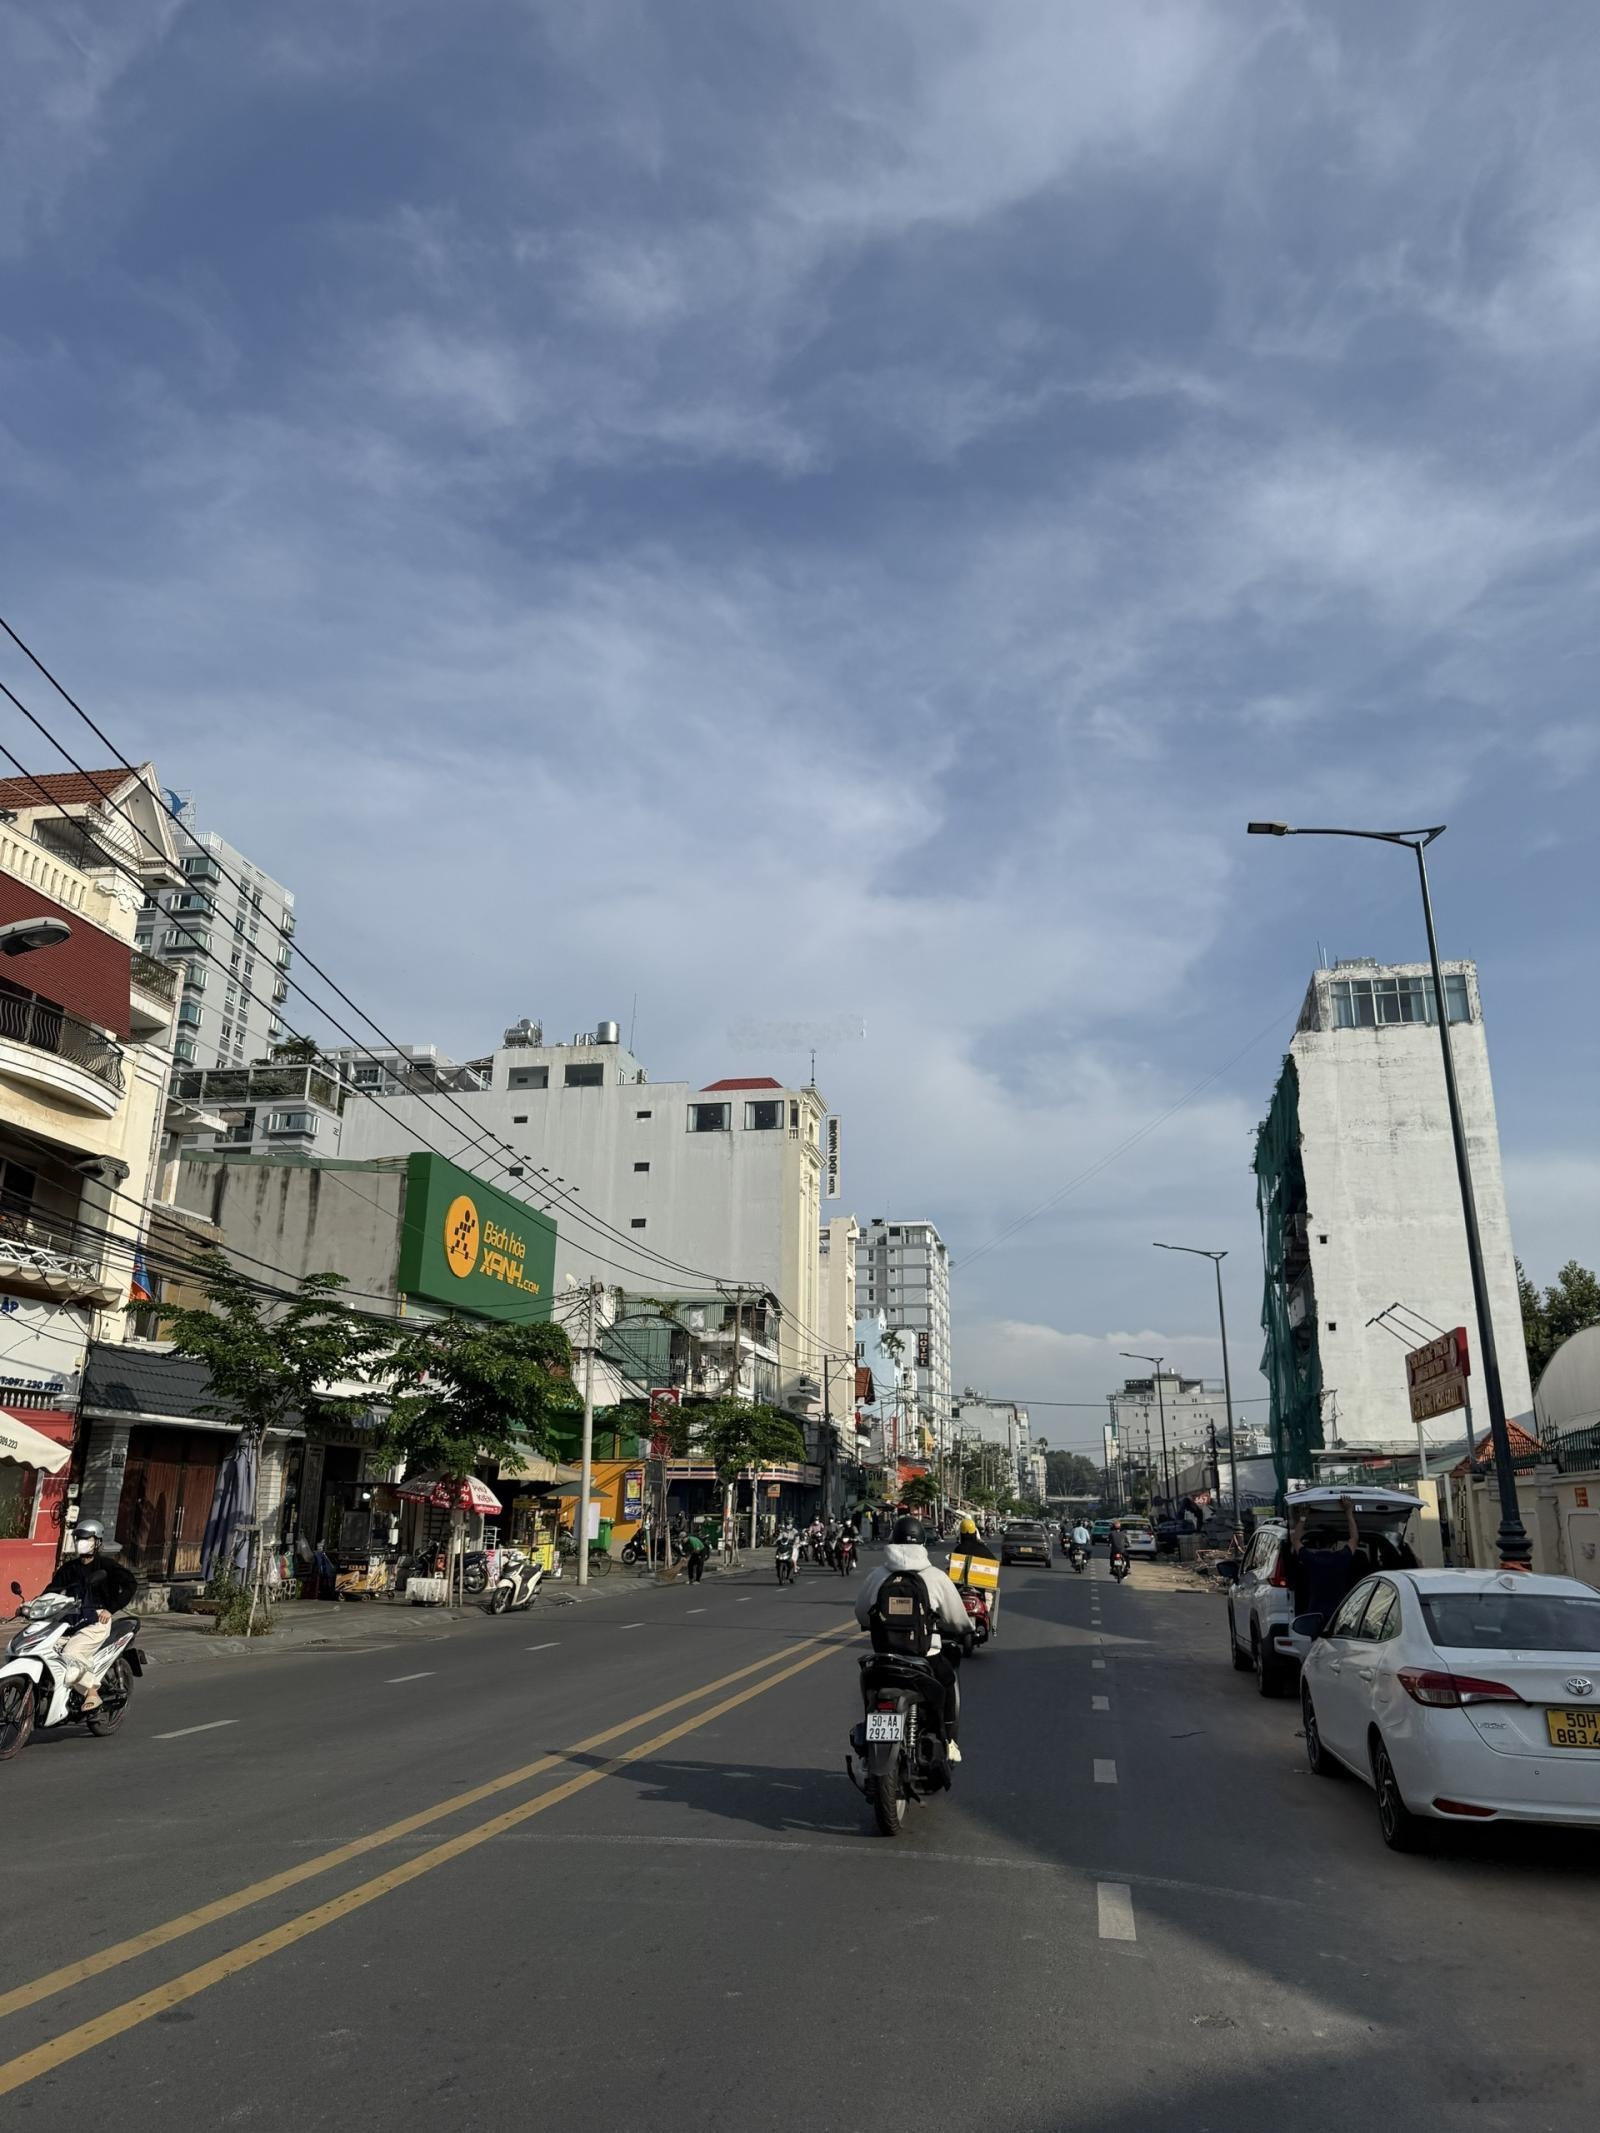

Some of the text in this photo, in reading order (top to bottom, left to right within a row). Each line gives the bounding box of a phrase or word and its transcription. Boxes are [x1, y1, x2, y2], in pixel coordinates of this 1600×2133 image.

[829, 1120, 838, 1154] BROWN
[829, 1155, 838, 1175] DOT
[483, 1220, 526, 1259] Bách hóa
[920, 1333, 928, 1366] HOTEL
[872, 1715, 898, 1727] 50-AA
[1566, 1712, 1597, 1728] 50H
[869, 1728, 900, 1739] 292.12
